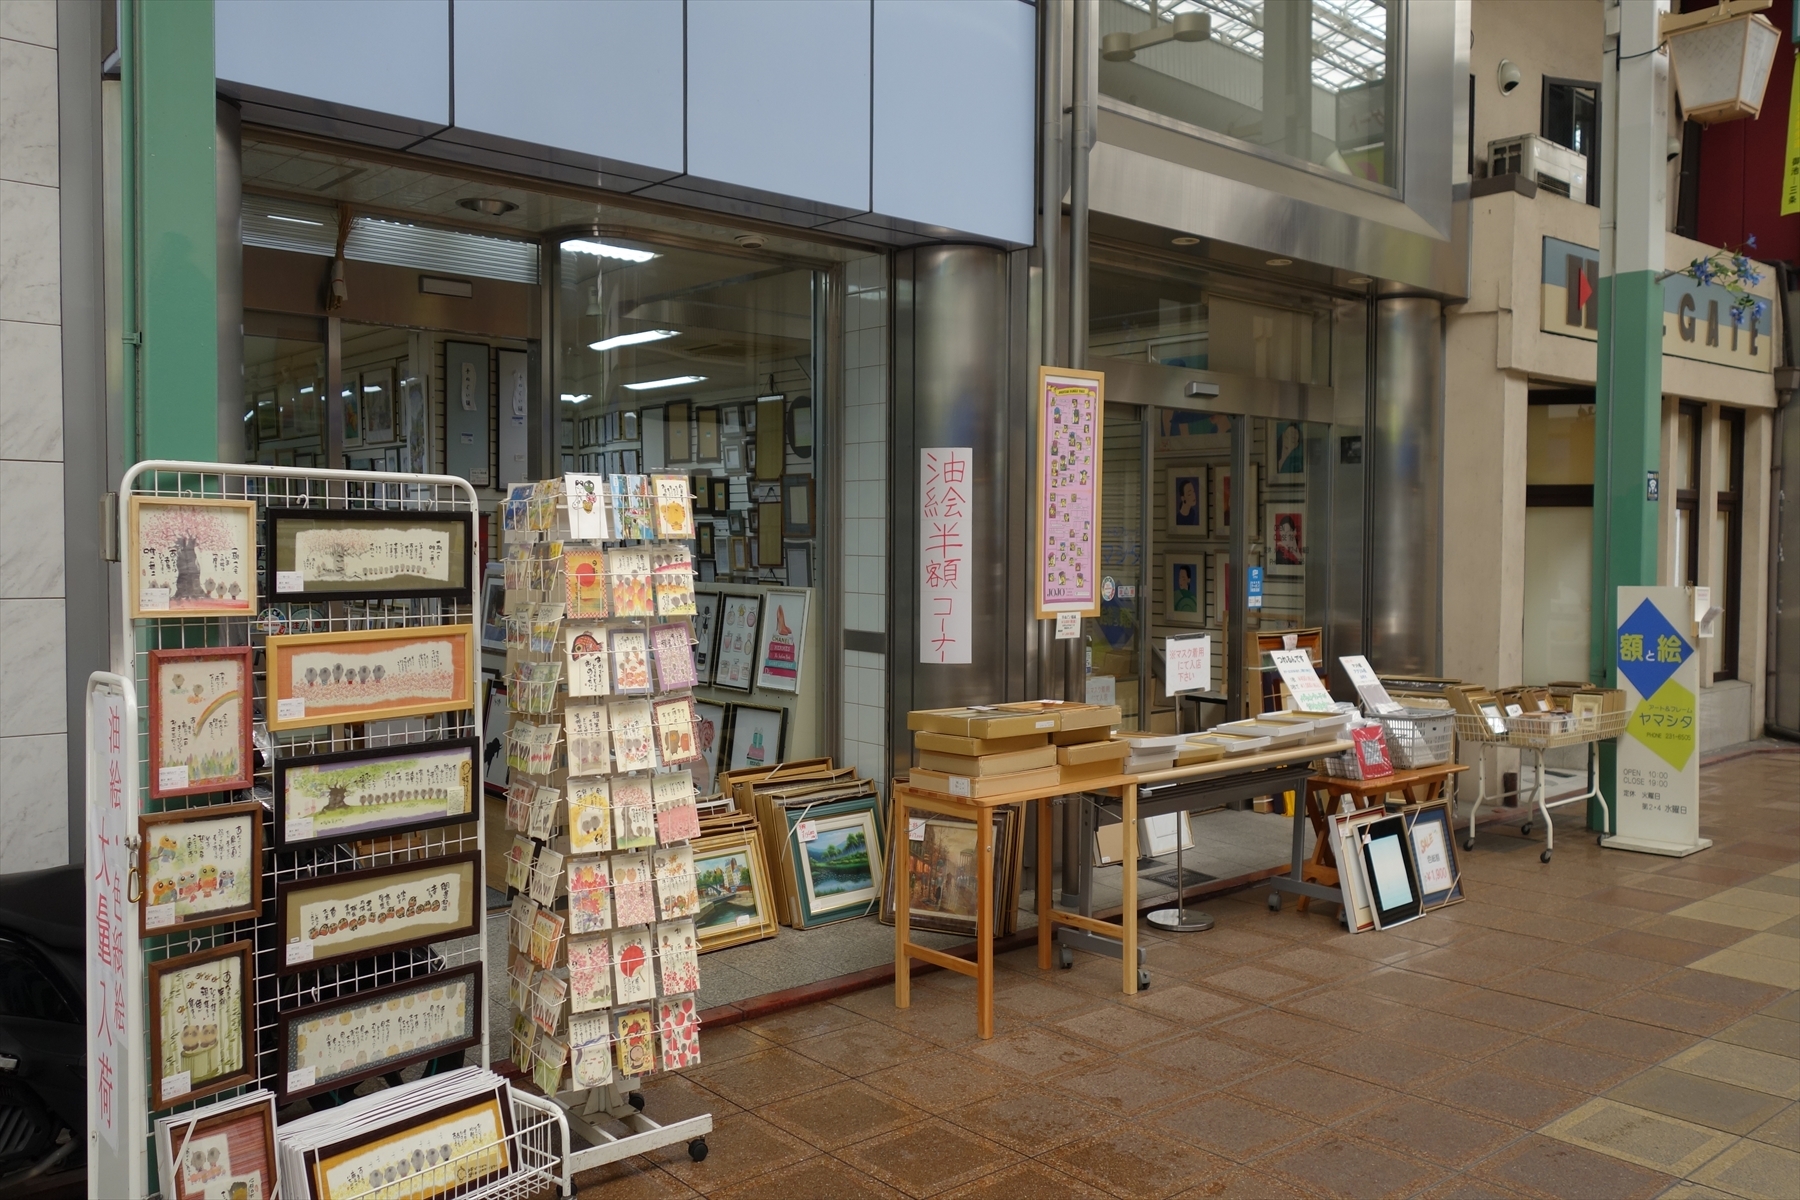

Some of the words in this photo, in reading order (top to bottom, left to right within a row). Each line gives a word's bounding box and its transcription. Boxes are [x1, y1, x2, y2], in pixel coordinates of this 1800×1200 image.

[924, 450, 967, 663] 油絵半額コーナー
[1046, 587, 1066, 597] JOJO
[1620, 632, 1683, 664] 額と絵
[1177, 659, 1202, 671] にて入店
[1178, 672, 1195, 683] 下さい
[1639, 712, 1693, 729] ヤマシタ
[1665, 733, 1692, 741] 231-6505
[1623, 768, 1641, 776] OPEN
[1648, 771, 1668, 779] 10:00
[1623, 777, 1645, 786] CLOSE
[1648, 779, 1668, 788] 19:00
[1623, 789, 1636, 797] 定休
[1641, 792, 1661, 800] 火曜日
[1664, 803, 1688, 815] 水曜日
[1420, 832, 1434, 854] SALE
